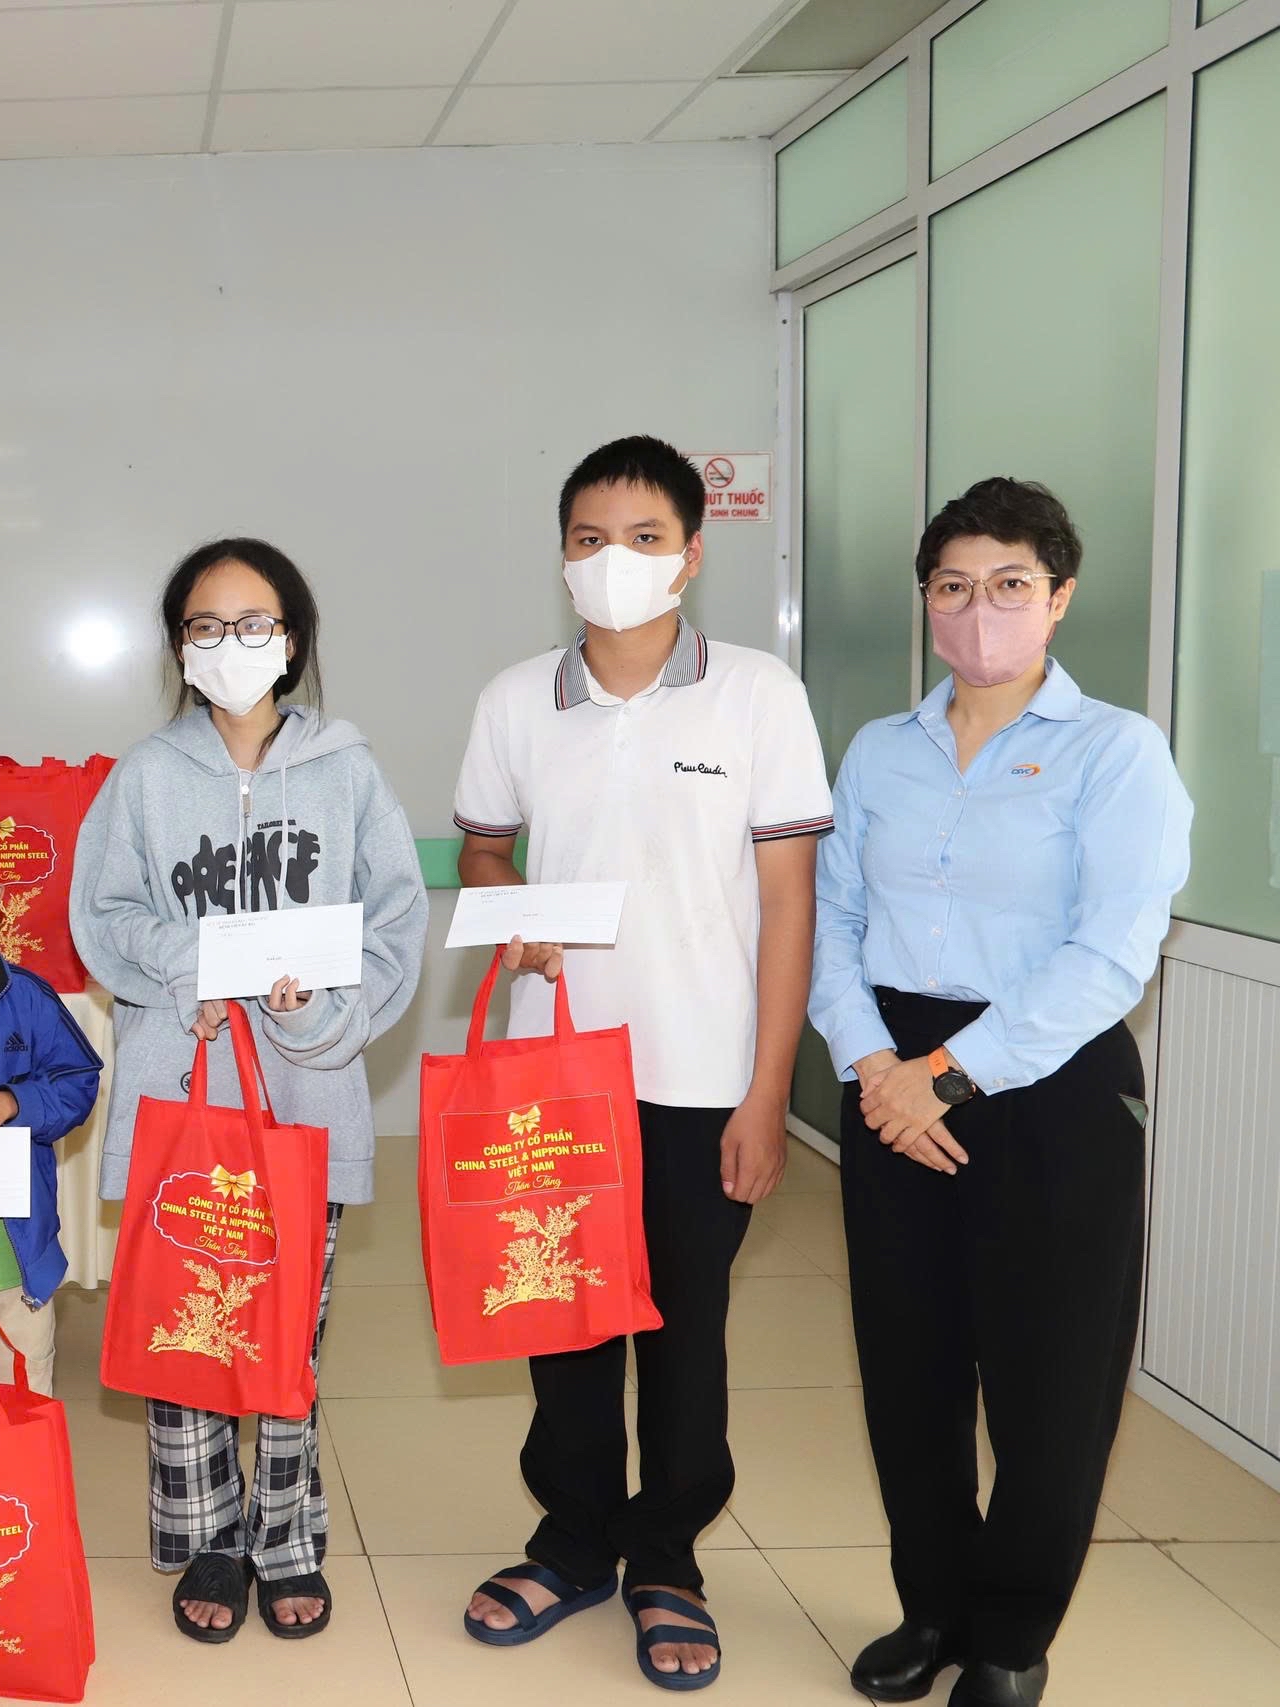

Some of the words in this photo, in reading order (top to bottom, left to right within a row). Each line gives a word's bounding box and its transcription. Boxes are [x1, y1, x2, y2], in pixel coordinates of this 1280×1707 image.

[728, 488, 764, 504] THUỐC
[710, 510, 728, 518] SINH
[732, 509, 759, 517] CHUNG
[484, 1143, 512, 1156] CÔNG
[514, 1139, 526, 1151] TY
[528, 1131, 540, 1146] CỔ
[455, 1161, 486, 1171] CHINA
[489, 1155, 519, 1169] STEEL
[522, 1151, 529, 1162] &
[532, 1146, 570, 1159] NIPPON
[573, 1143, 606, 1154] STEEL
[508, 1165, 528, 1179] VIỆT
[532, 1160, 555, 1172] NAM
[504, 1180, 530, 1196] Thân
[188, 1196, 213, 1210] CÔNG
[216, 1202, 227, 1212] TY
[229, 1202, 240, 1214] CỔ
[161, 1202, 187, 1216] CHINA
[190, 1209, 216, 1222] STEEL
[220, 1216, 227, 1225] &
[230, 1217, 260, 1231] NIPPON
[204, 1224, 224, 1236] VIỆT
[226, 1230, 244, 1240] NAM
[195, 1235, 220, 1251] Thân
